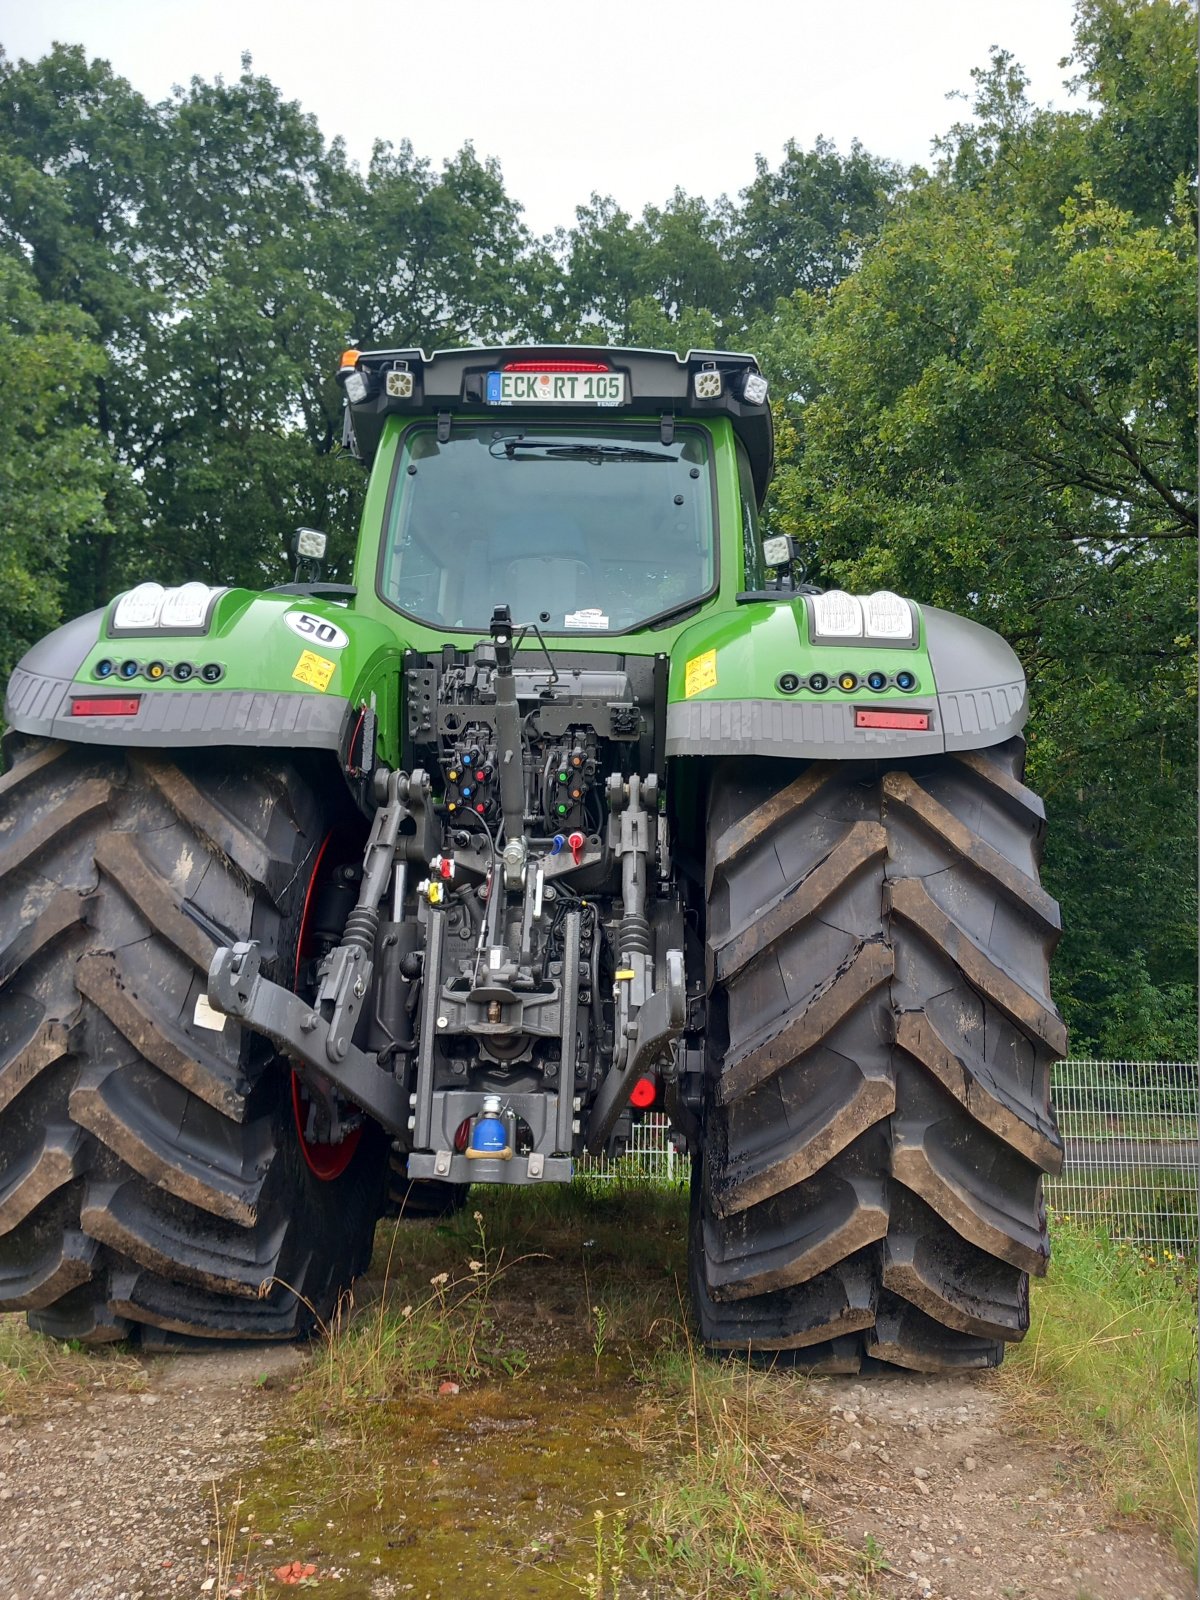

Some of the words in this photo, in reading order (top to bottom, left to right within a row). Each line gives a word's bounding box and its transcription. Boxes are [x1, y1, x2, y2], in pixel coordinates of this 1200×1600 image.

[502, 376, 538, 398] ECK
[554, 376, 579, 399] RT
[584, 377, 620, 399] 105
[296, 615, 337, 642] 50
